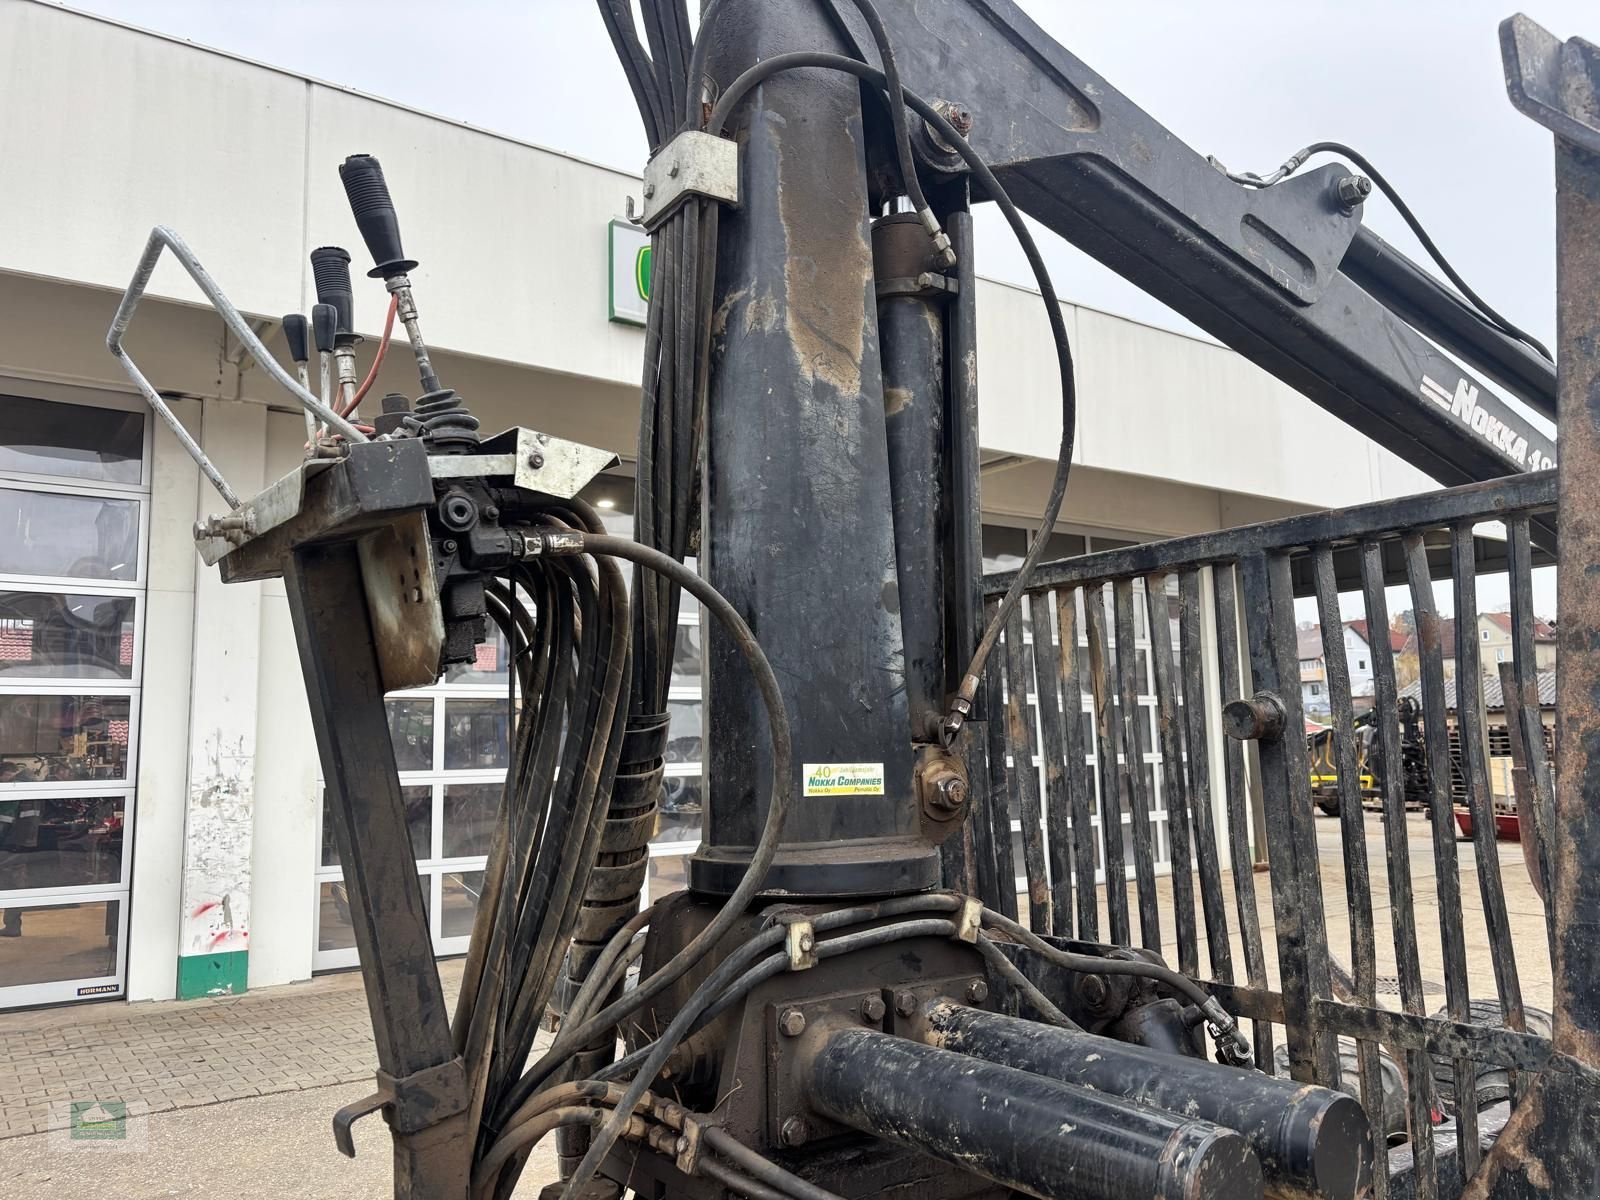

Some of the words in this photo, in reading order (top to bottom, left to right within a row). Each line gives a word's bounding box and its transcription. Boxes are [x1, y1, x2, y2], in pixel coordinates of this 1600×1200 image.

[1451, 377, 1529, 465] NOKKA
[808, 776, 836, 787] NOKKA
[838, 775, 882, 786] COMPANIES
